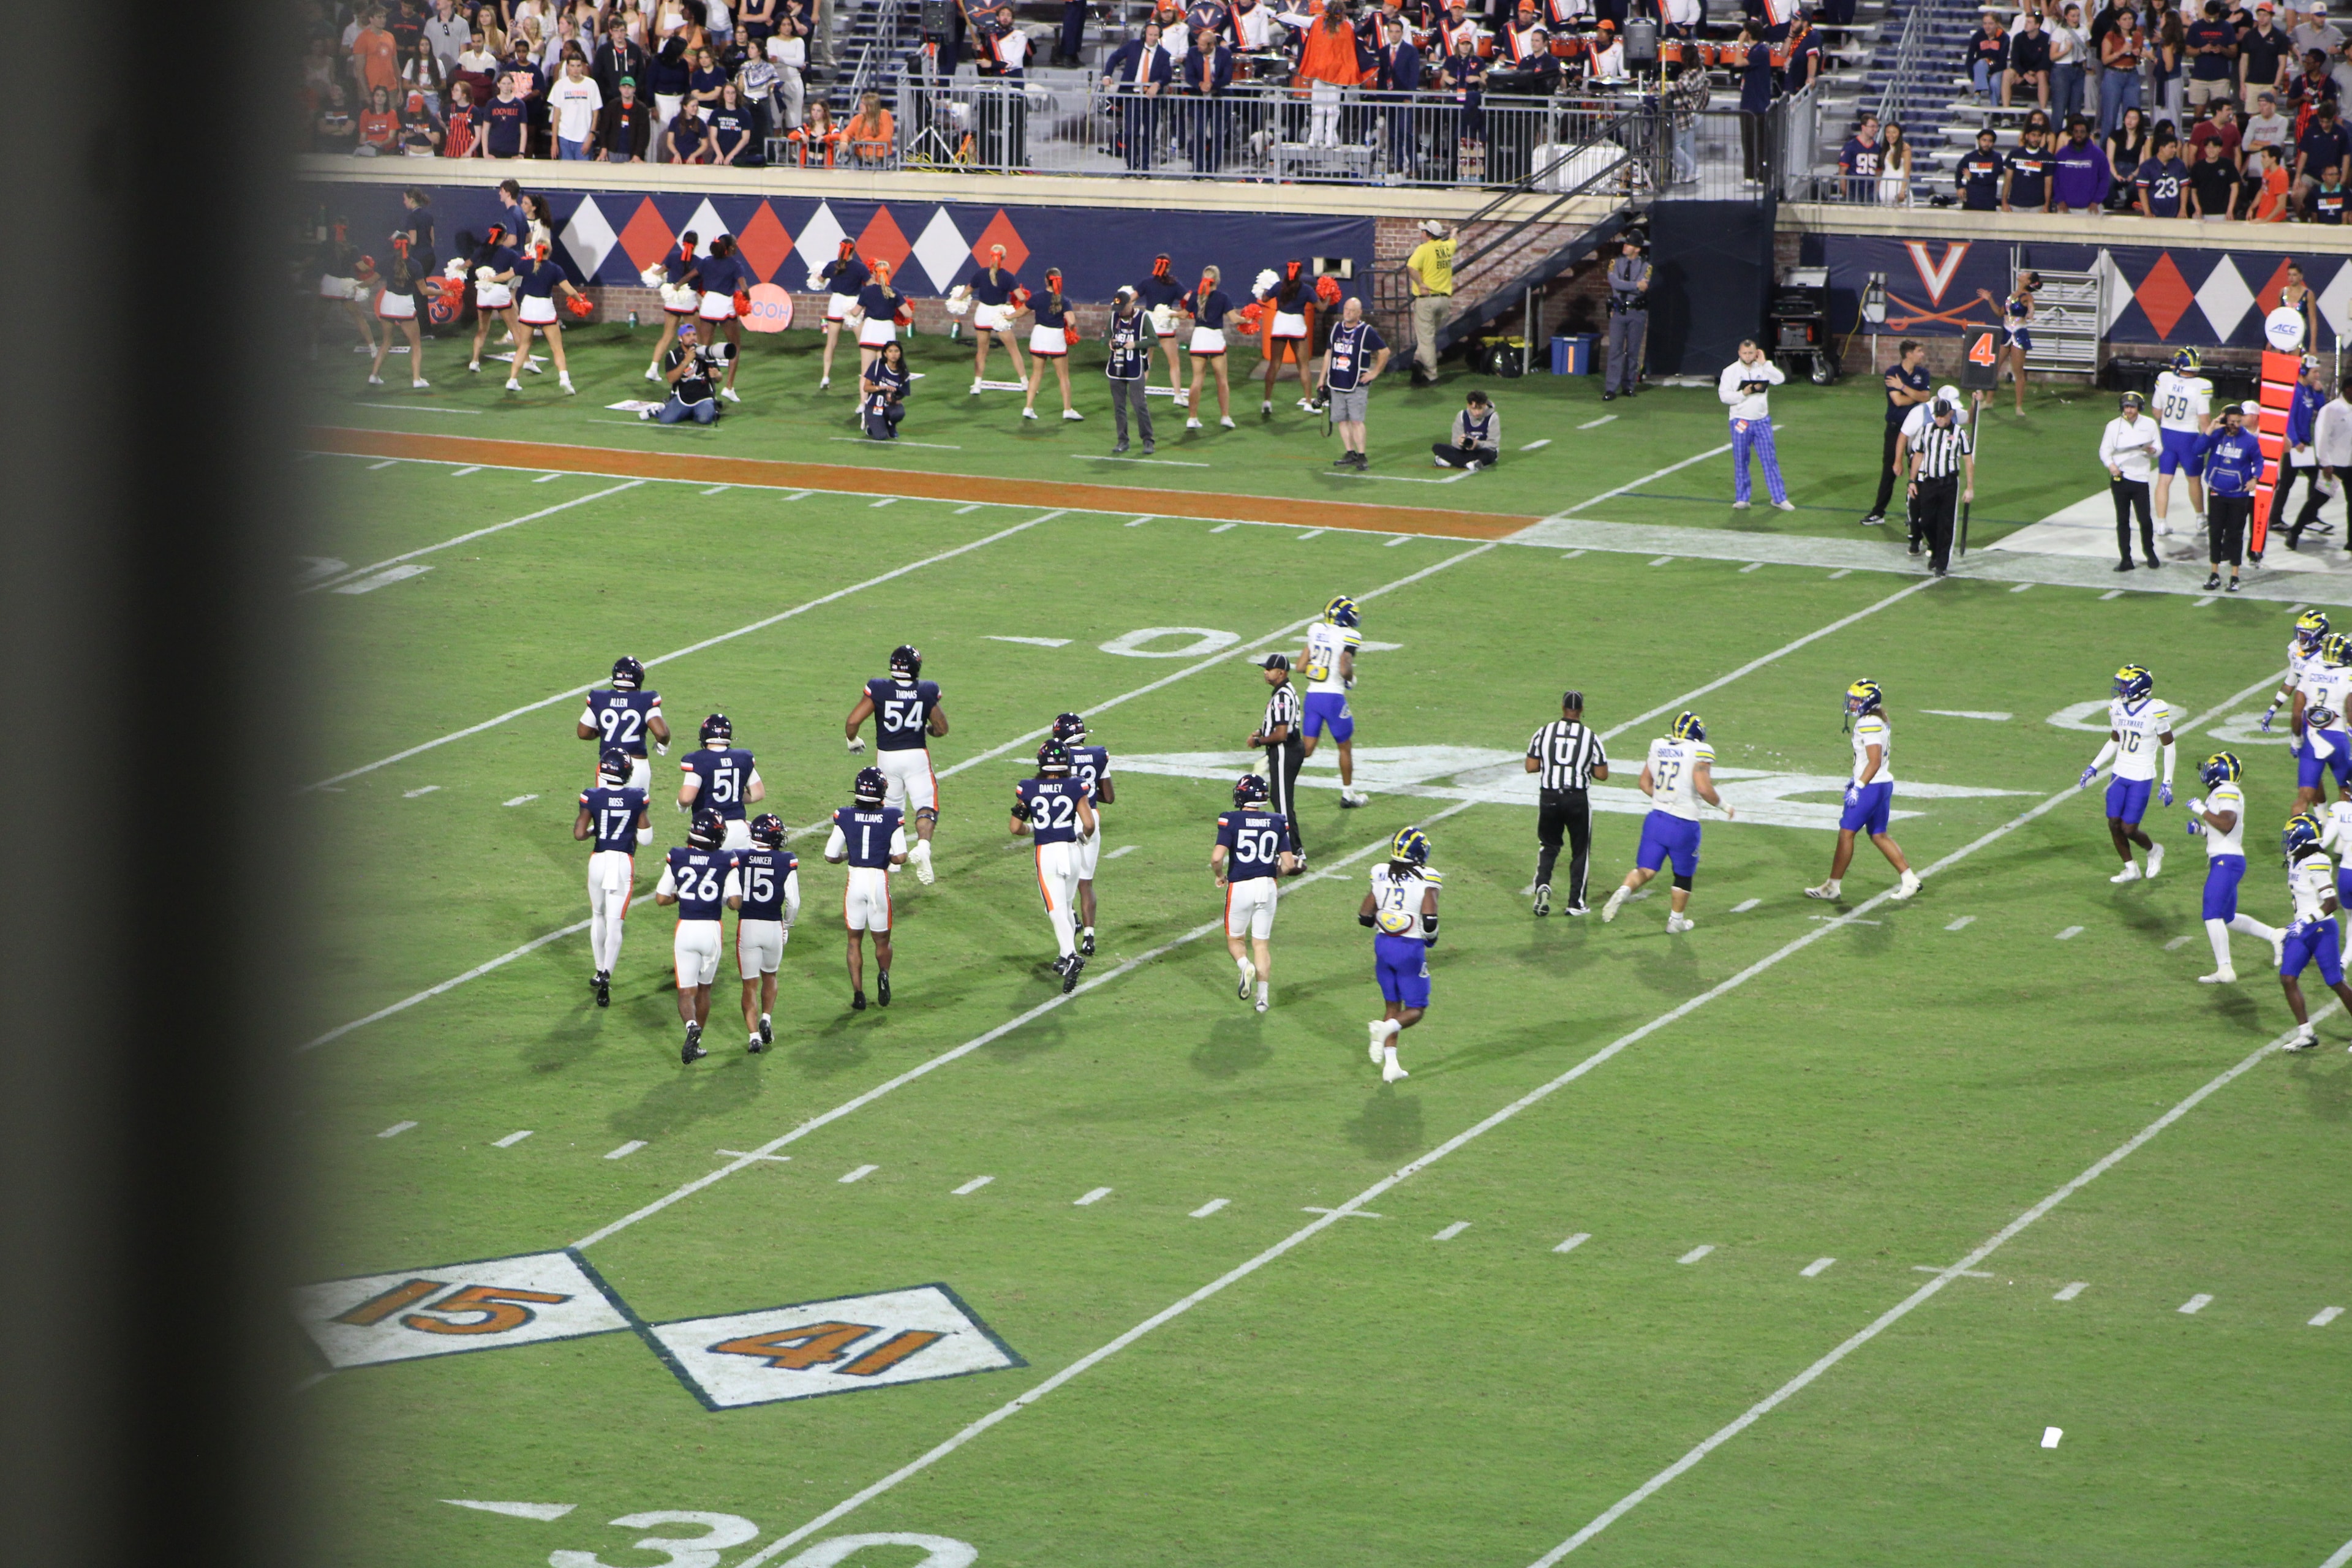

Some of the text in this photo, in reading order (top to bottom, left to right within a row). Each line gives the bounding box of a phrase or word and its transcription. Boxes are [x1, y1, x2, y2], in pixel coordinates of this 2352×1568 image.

[1856, 153, 1879, 176] 95
[2154, 176, 2179, 199] 23
[2269, 323, 2299, 335] ACC
[1969, 333, 1995, 367] 4
[2172, 383, 2185, 393] RAY
[2164, 394, 2188, 421] 89
[609, 698, 628, 707] ALLEN
[895, 689, 918, 699] THOMAS
[600, 708, 641, 743] 92
[883, 701, 923, 733] 54
[2118, 718, 2144, 729] DELAWARE
[720, 758, 733, 767] REID
[1074, 754, 1093, 764] BROWN
[1555, 737, 1577, 765] U
[712, 768, 740, 803] 51
[1071, 765, 1096, 798] 3
[1655, 760, 1680, 791] 52
[1039, 783, 1063, 794] DANLEY
[608, 797, 624, 807] ROSS
[1030, 795, 1074, 829] 32
[599, 809, 631, 840] 17
[854, 813, 883, 823] WILLIAMS
[1245, 817, 1272, 827] RUBINOFF
[861, 825, 870, 859] 1
[1236, 829, 1278, 864] 50
[689, 854, 710, 865] HARDY
[748, 855, 772, 865] SANKER
[677, 866, 718, 902] 26
[742, 866, 775, 902] 15
[1382, 887, 1405, 910] 13
[328, 1277, 574, 1335] 15
[707, 1319, 949, 1378] 41
